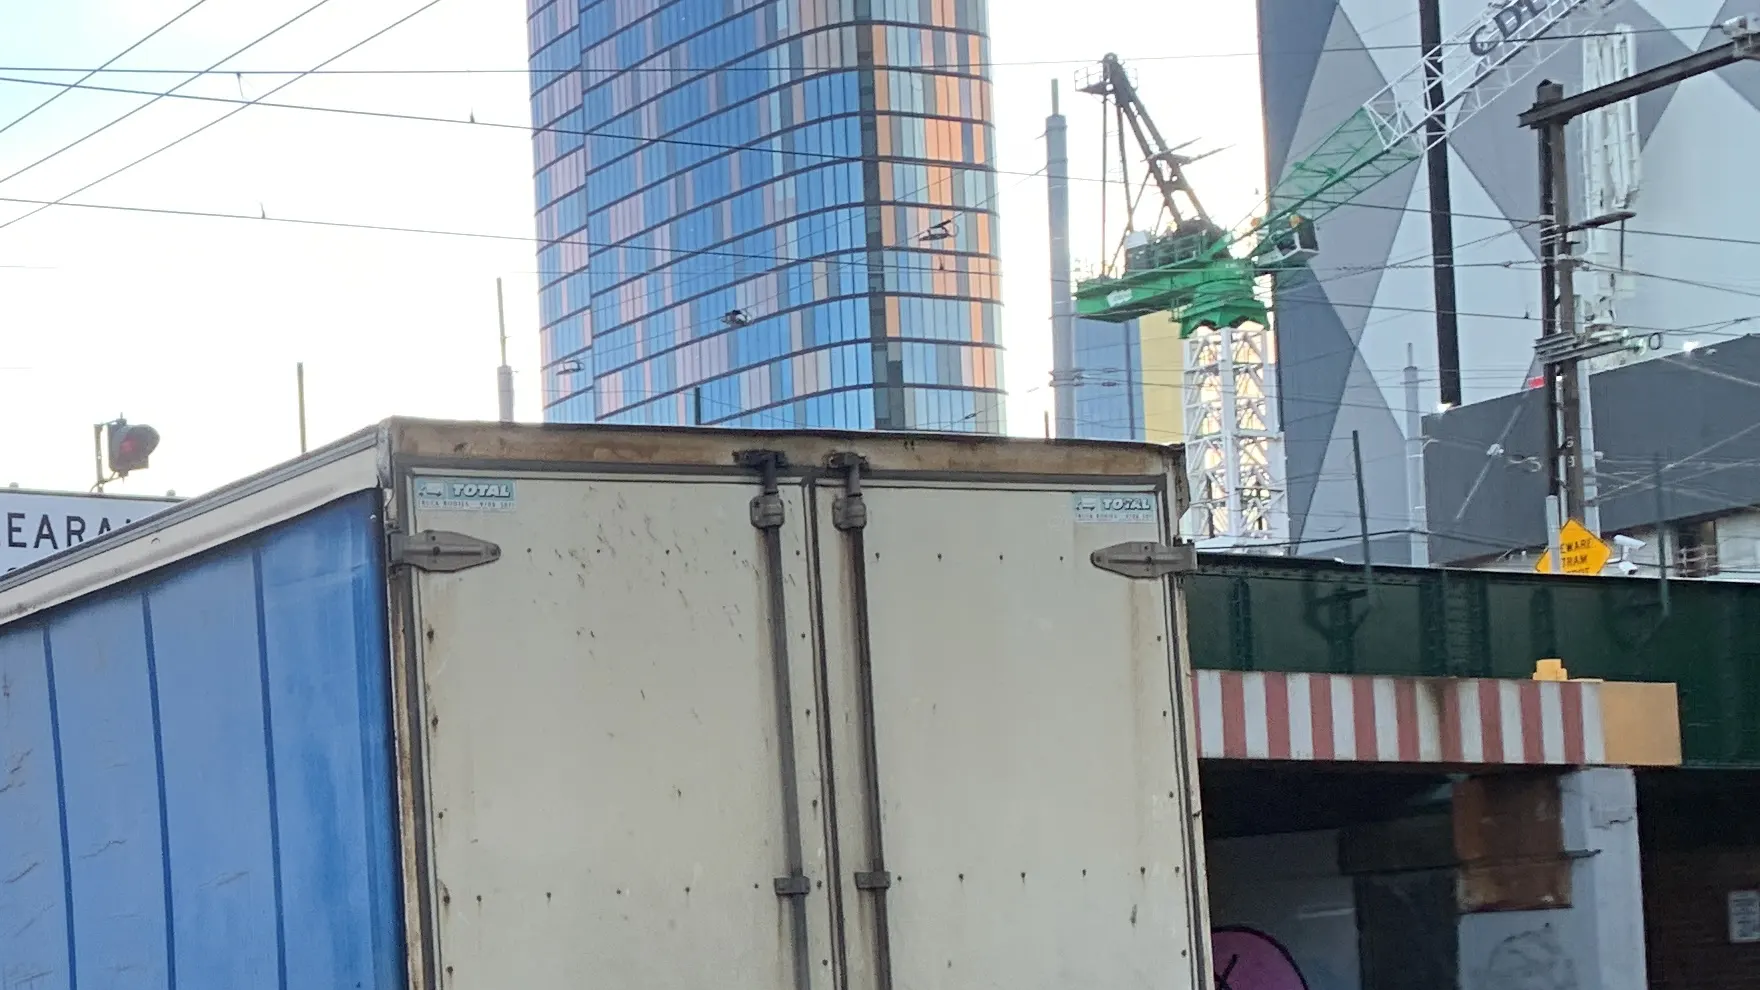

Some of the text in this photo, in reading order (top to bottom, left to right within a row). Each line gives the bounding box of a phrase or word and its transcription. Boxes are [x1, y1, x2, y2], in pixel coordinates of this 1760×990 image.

[452, 483, 511, 498] TOTAL
[1102, 498, 1152, 511] TOTAL
[1560, 539, 1593, 554] EWARE
